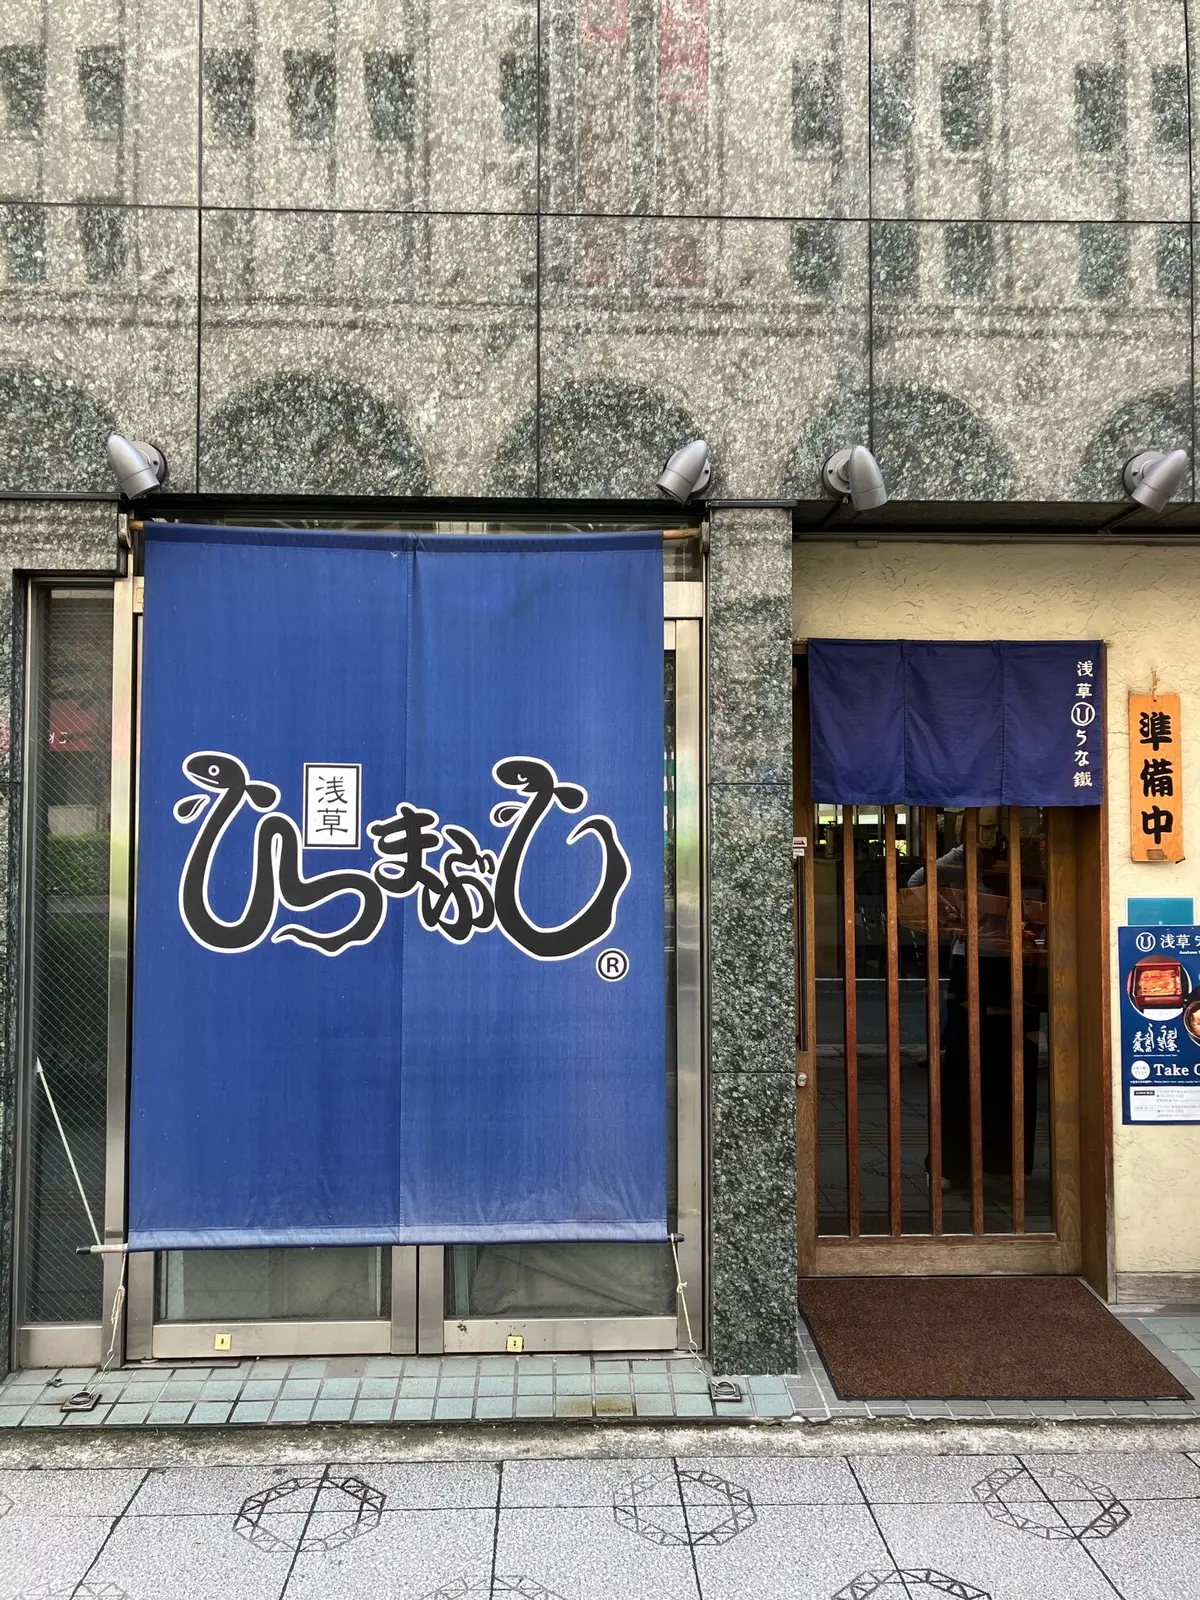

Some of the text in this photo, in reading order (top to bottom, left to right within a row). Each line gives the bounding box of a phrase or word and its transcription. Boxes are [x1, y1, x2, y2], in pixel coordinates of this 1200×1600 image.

[1075, 660, 1094, 698] 浅草
[315, 775, 349, 837] 浅草
[1138, 711, 1174, 845] 準備中
[176, 750, 632, 963] ひつまぶし
[1153, 1063, 1190, 1076] Take
